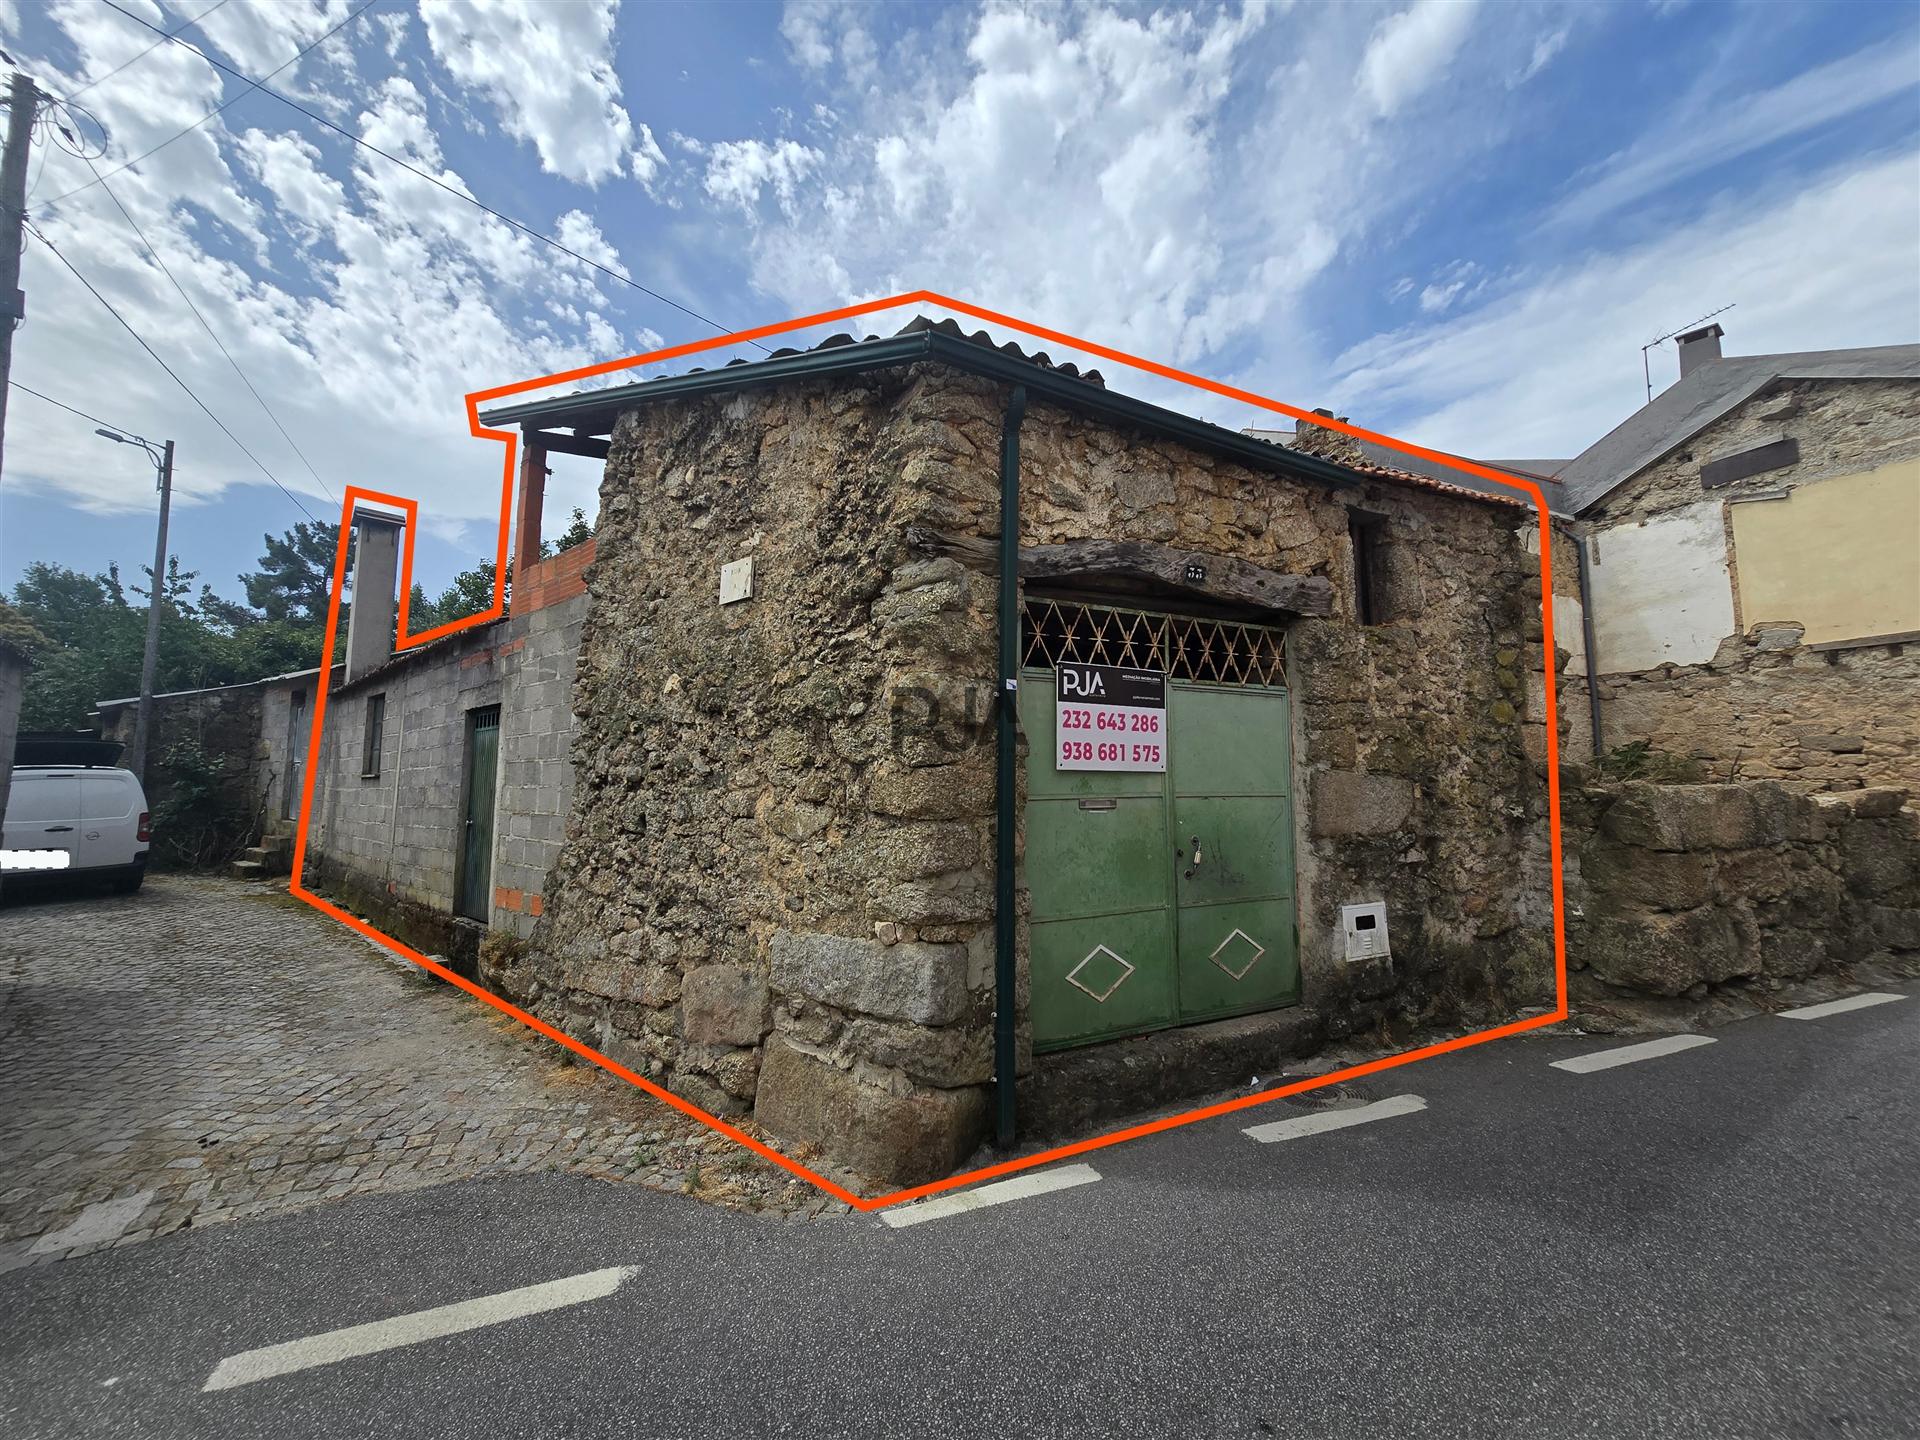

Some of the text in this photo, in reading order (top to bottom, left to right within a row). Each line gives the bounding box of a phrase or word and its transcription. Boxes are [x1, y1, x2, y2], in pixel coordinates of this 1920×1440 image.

[1063, 669, 1106, 696] PJA
[1062, 709, 1159, 733] 232 643 286
[1062, 741, 1160, 763] 938 681 575
